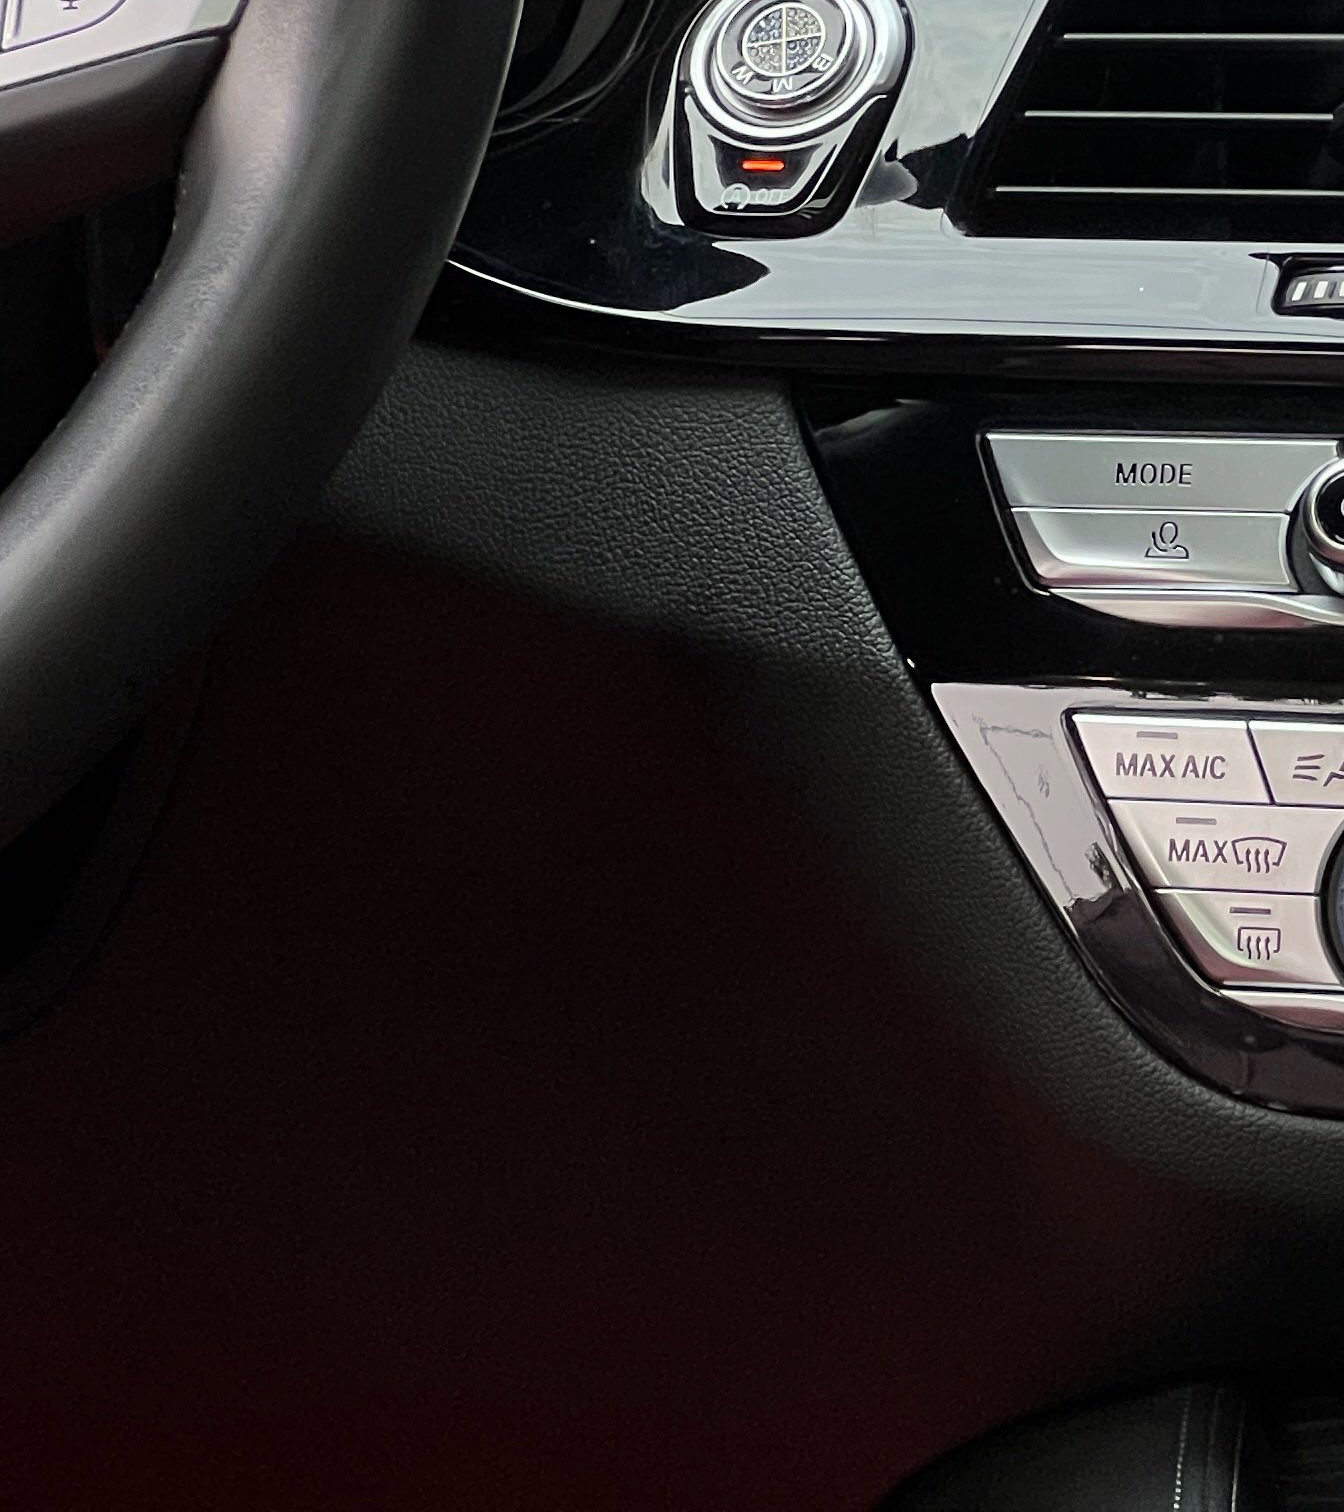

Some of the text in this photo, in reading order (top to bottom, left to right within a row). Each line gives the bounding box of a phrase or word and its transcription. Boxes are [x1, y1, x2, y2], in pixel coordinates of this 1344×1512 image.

[1115, 462, 1193, 486] MODE
[1115, 752, 1227, 780] MAX A/C
[1168, 838, 1228, 864] MAX
